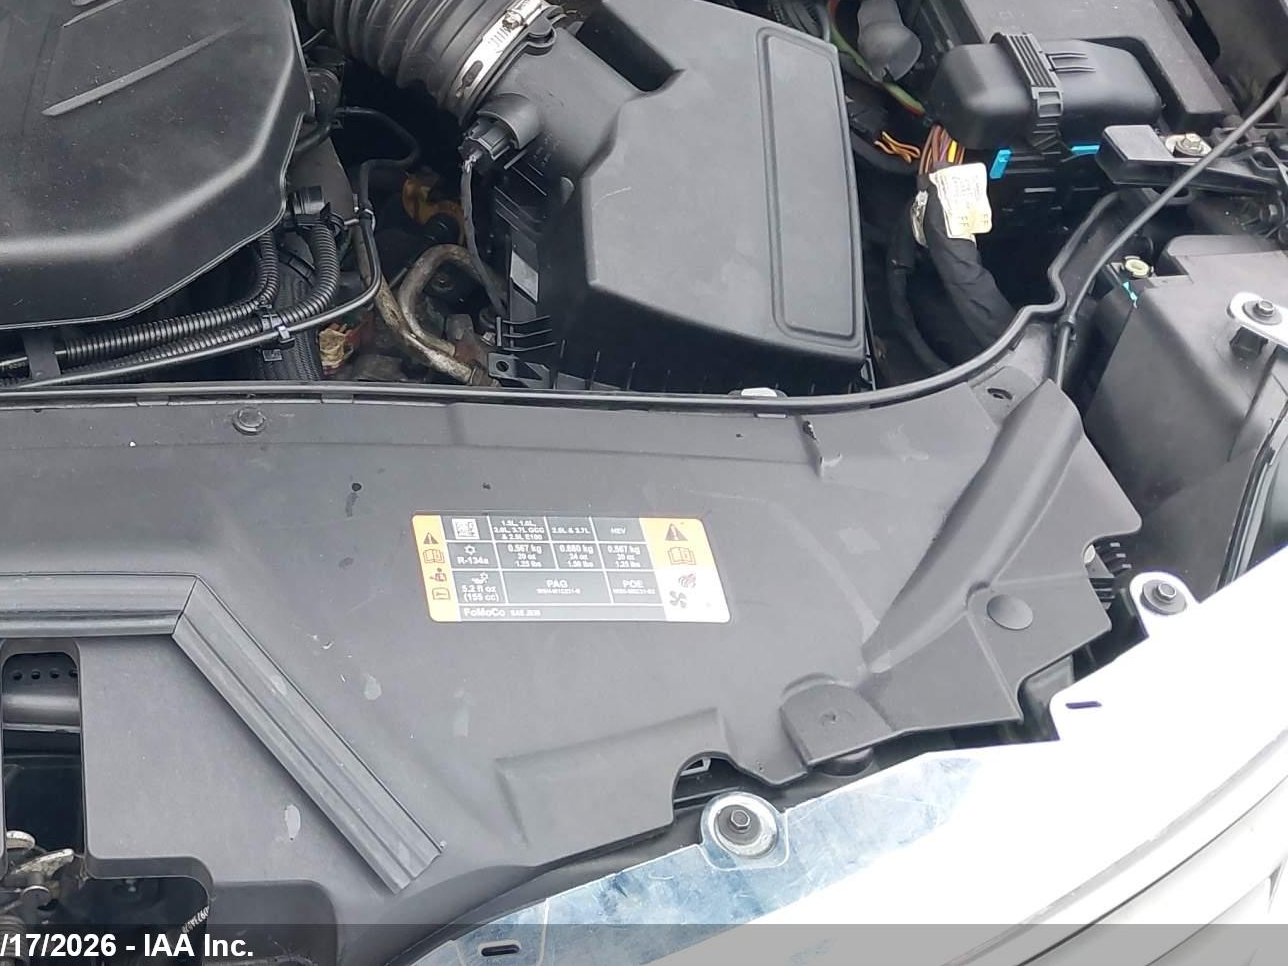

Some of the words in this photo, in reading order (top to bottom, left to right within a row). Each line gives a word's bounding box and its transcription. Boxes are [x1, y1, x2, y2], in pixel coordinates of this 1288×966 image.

[531, 544, 542, 554] kg
[583, 545, 594, 554] kg
[630, 546, 640, 555] kg
[457, 556, 489, 565] R-134a
[462, 584, 477, 592] 5.2
[546, 580, 568, 588] PAG
[622, 580, 645, 588] POE
[464, 608, 506, 617] FoMoCo
